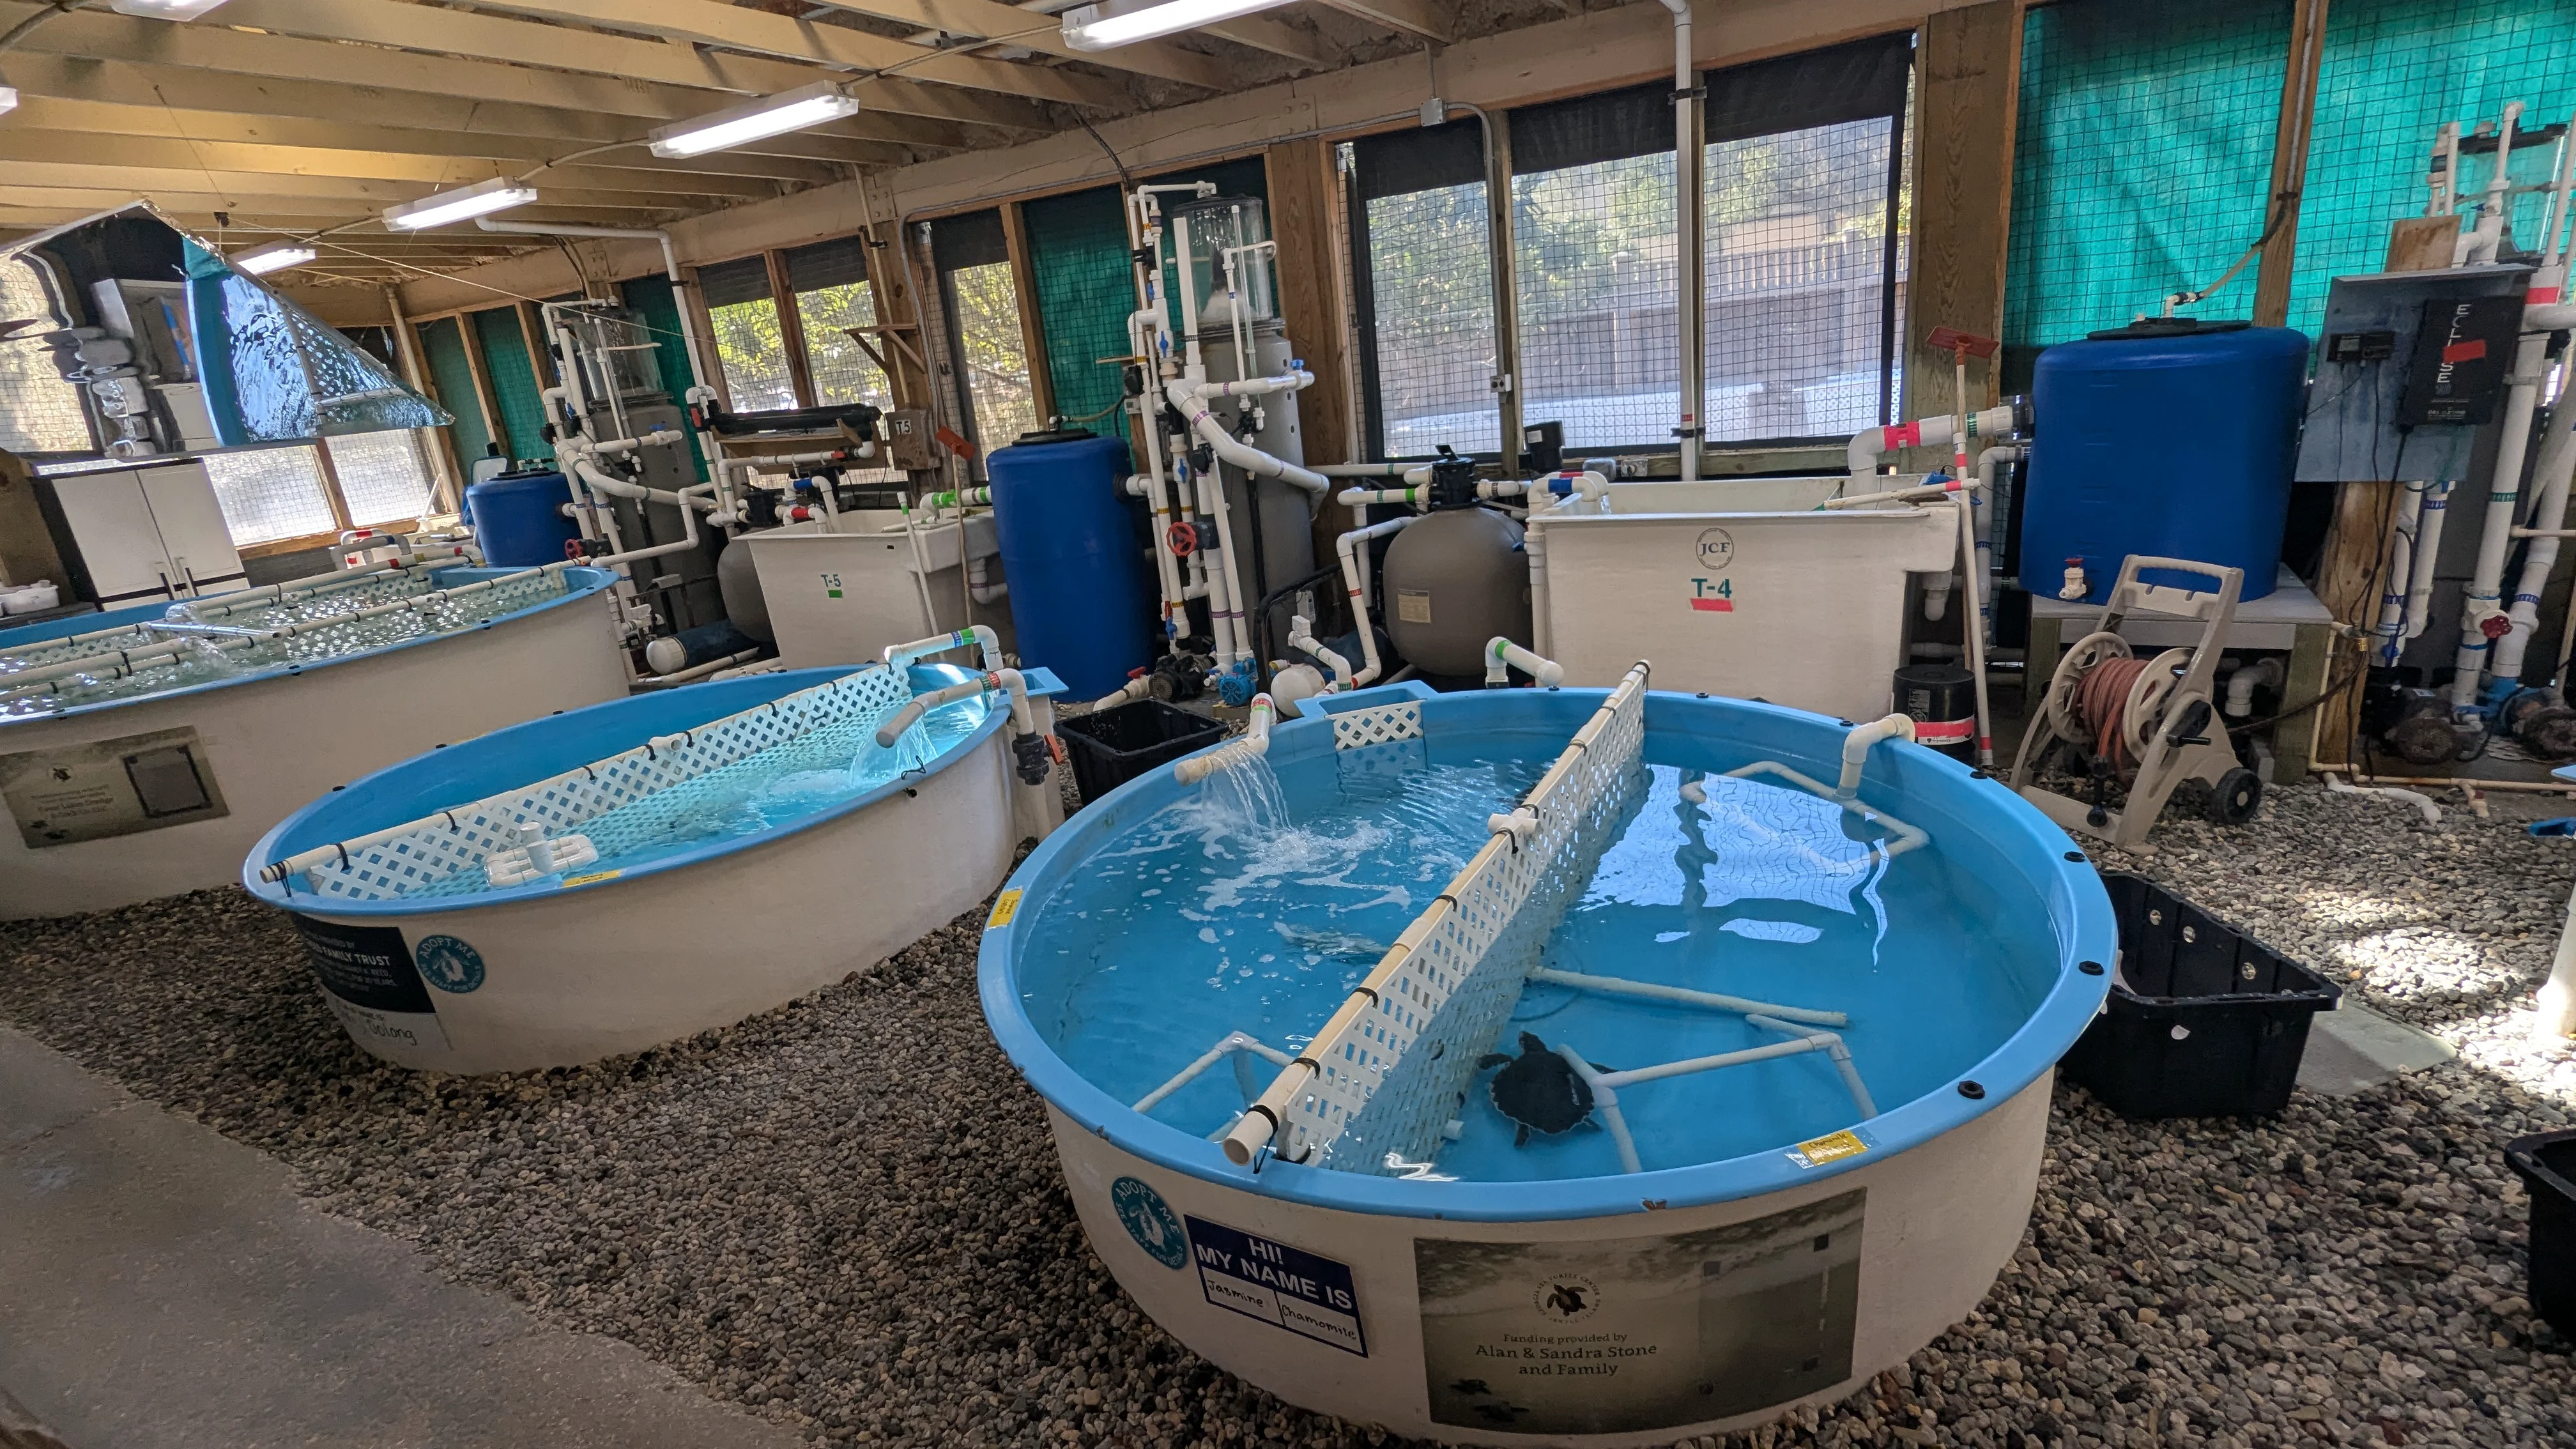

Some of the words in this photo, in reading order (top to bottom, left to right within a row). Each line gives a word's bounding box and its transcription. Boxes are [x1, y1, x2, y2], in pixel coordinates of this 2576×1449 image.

[2437, 304, 2472, 383] ECLISE
[896, 420, 910, 434] T5
[1699, 542, 1731, 556] JCF
[820, 574, 841, 588] T-5
[1691, 578, 1732, 598] T-4
[419, 937, 453, 958] ADOPT
[456, 942, 476, 958] ME
[354, 953, 391, 967] TRUST
[1115, 1181, 1157, 1204] ADOPT
[1158, 1206, 1180, 1234] ME
[1248, 1238, 1283, 1265] HI!
[1195, 1243, 1232, 1270] MY
[1239, 1258, 1317, 1300] NAME
[1326, 1285, 1353, 1310] IS
[1207, 1280, 1264, 1308] Jasmine
[1282, 1304, 1357, 1340] Chamomile
[1503, 1333, 1554, 1345] Funding
[1557, 1333, 1610, 1346] provided
[1613, 1333, 1627, 1343] by
[1475, 1344, 1519, 1358] Alan
[1523, 1347, 1535, 1358] &
[1540, 1347, 1602, 1360] Sandra
[1607, 1344, 1657, 1358] Stone
[1519, 1363, 1552, 1376] and
[1558, 1363, 1618, 1376] Family
